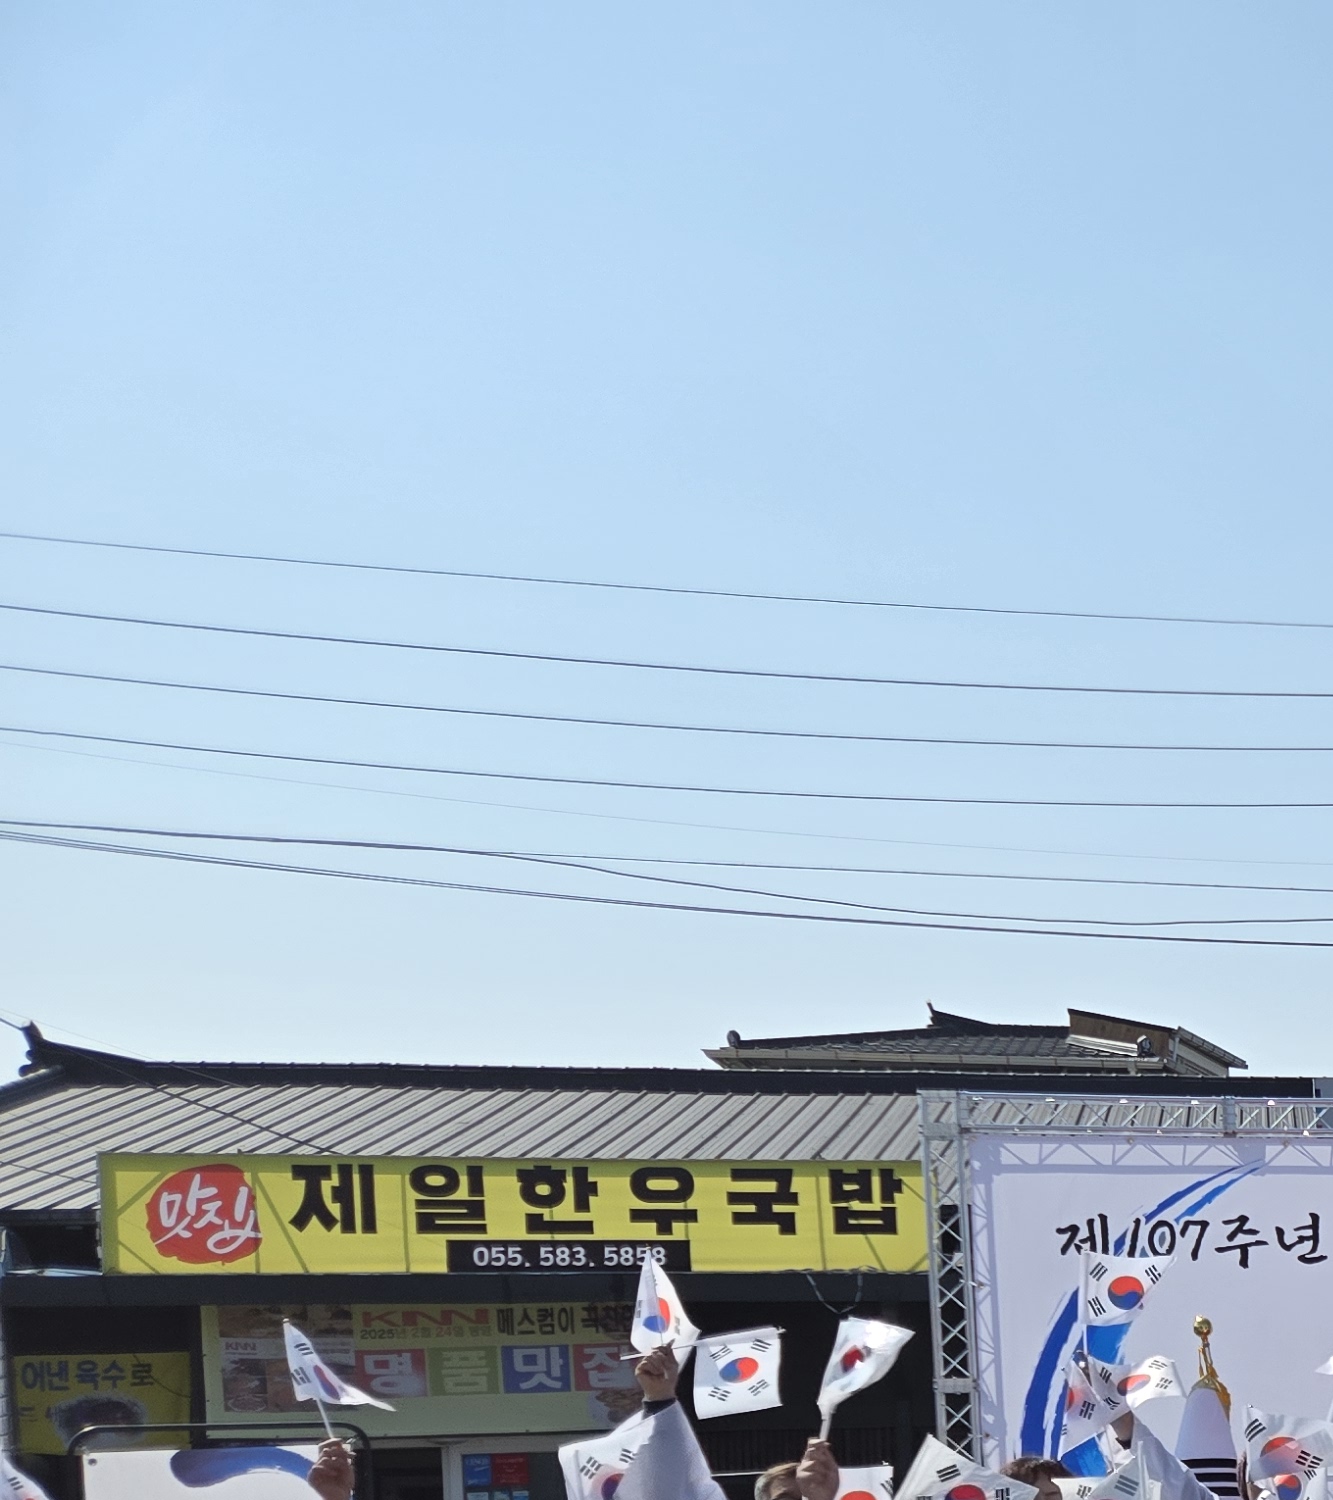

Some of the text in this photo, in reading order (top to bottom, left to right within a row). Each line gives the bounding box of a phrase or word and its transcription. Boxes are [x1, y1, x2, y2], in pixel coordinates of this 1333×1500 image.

[155, 1163, 904, 1255] 맛집 제일한우국밥
[1056, 1212, 1328, 1269] 제107주년
[362, 1308, 490, 1328] KNN
[496, 1307, 575, 1336] 메스컴이
